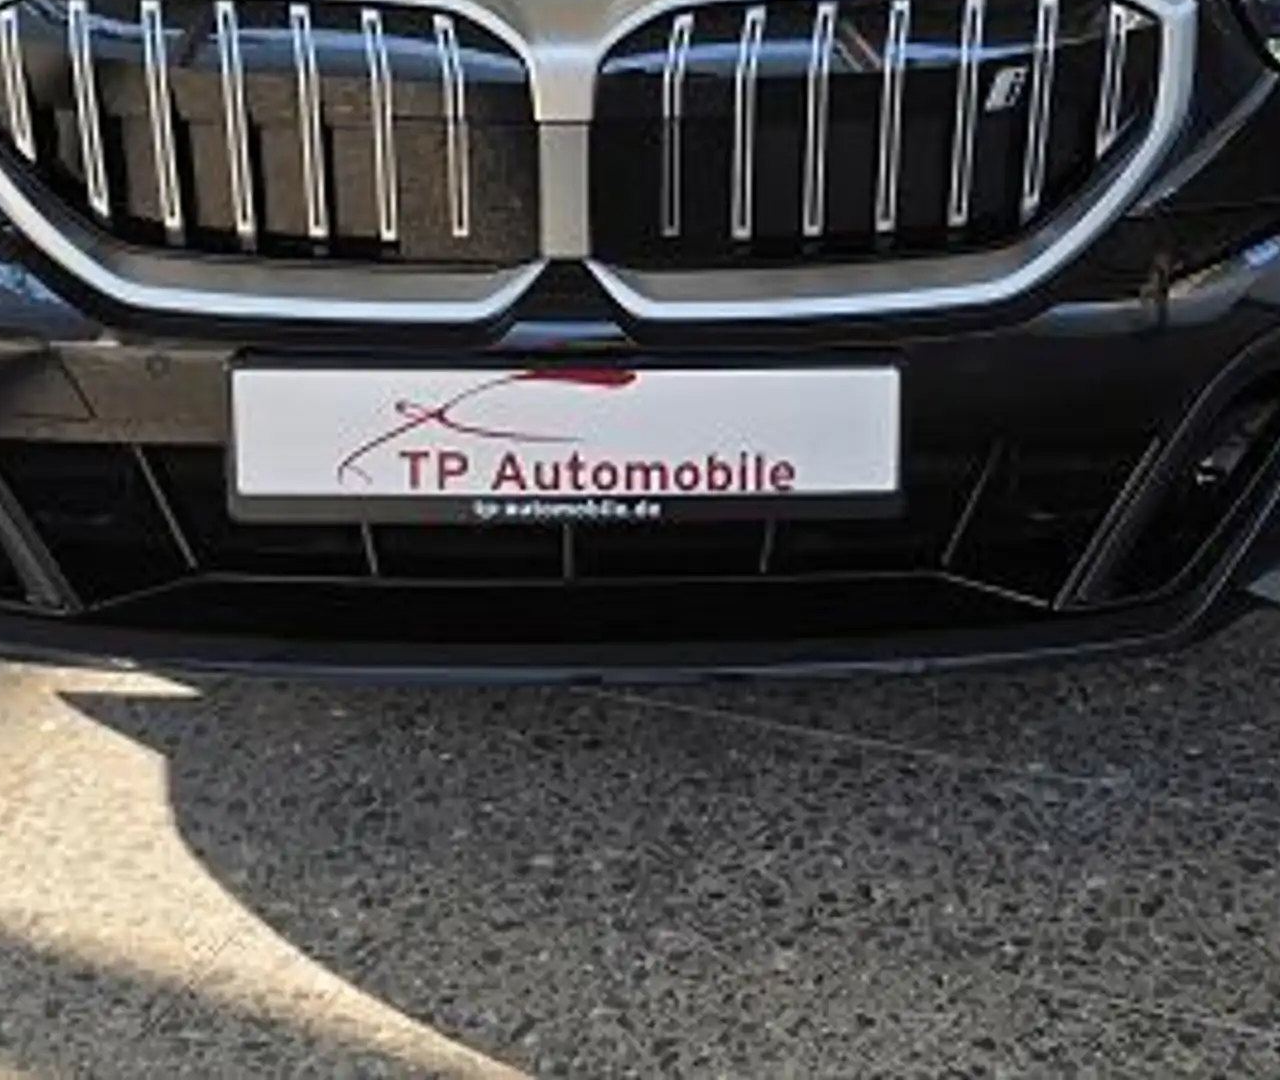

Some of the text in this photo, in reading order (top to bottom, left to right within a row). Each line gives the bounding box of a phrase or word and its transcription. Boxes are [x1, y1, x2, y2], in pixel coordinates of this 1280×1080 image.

[399, 450, 796, 491] TP Automobile
[472, 498, 662, 520] tpautomobile.de
